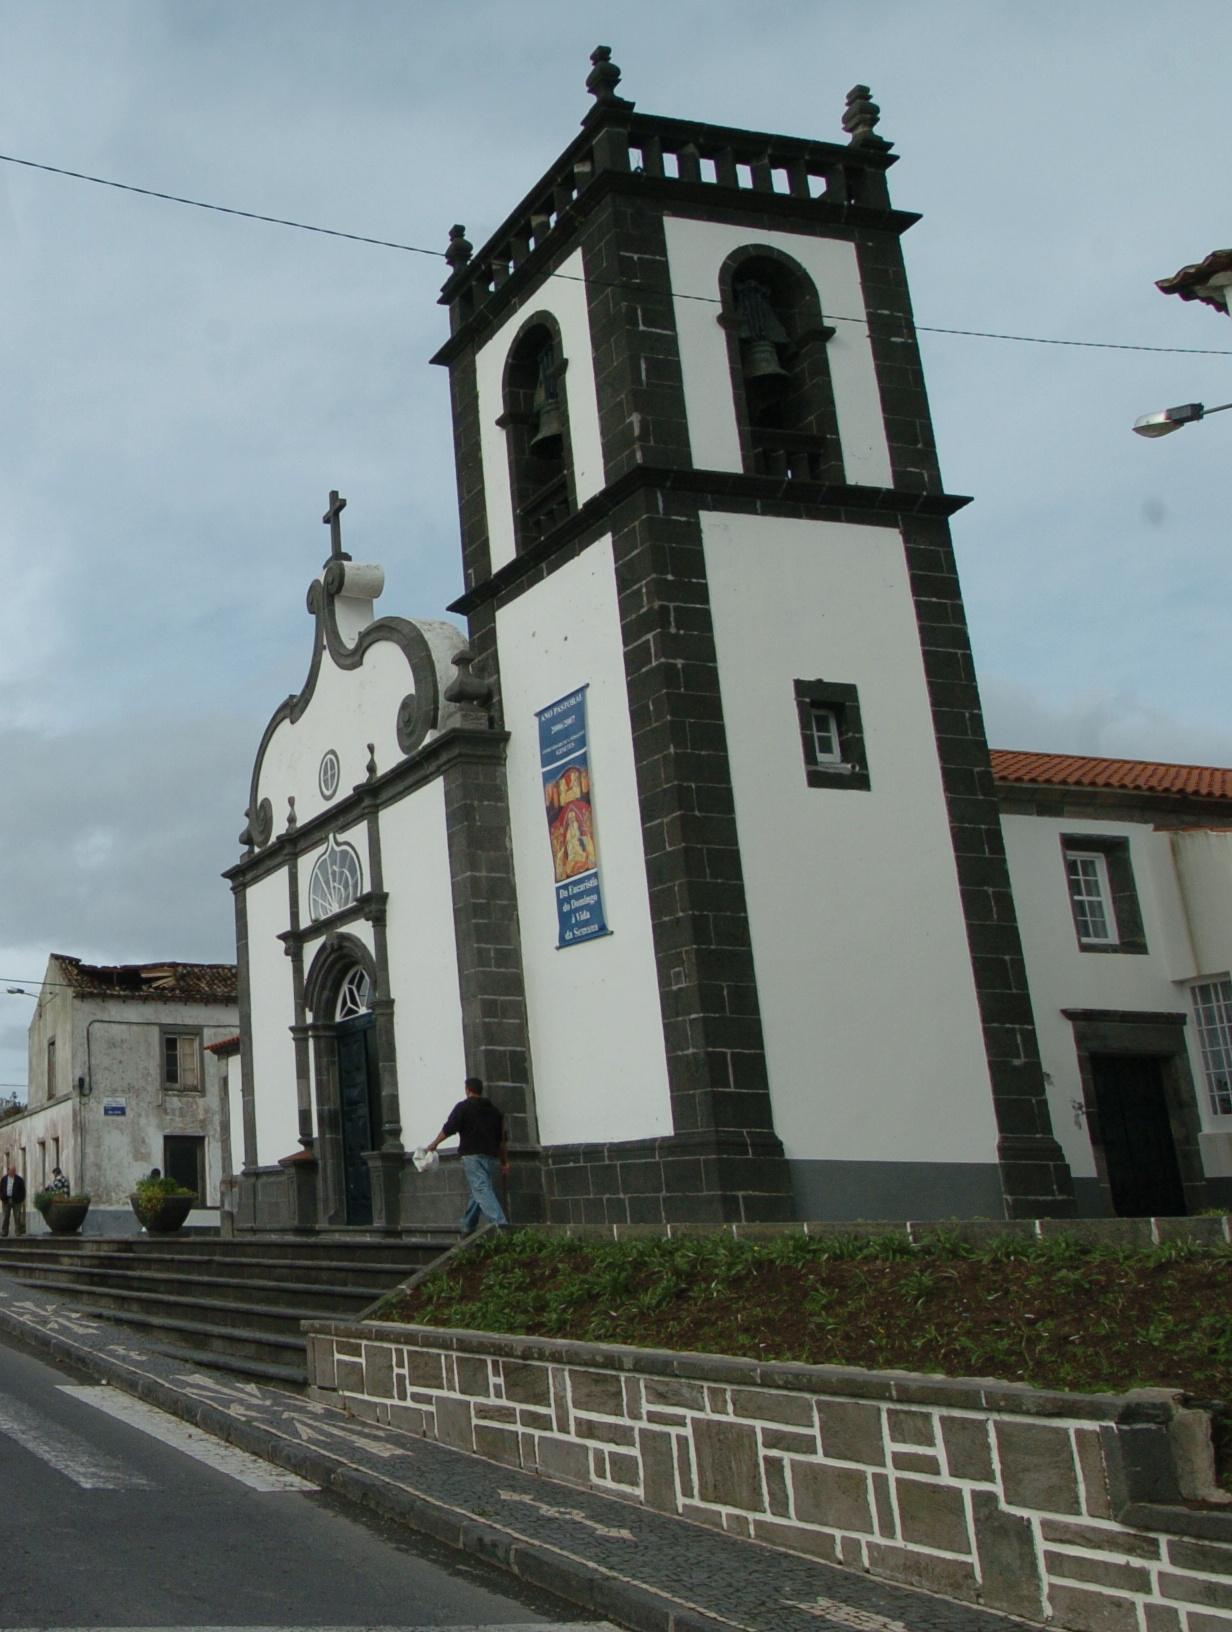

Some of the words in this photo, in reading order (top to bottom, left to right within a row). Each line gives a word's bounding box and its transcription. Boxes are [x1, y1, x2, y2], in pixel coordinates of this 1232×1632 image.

[541, 710, 553, 721] ANO
[553, 692, 583, 716] PASTORAL
[568, 876, 598, 895] Eucaristia
[562, 902, 571, 912] do
[570, 894, 598, 909] Domingo
[575, 909, 591, 921] Vida
[564, 929, 574, 940] da
[573, 923, 599, 938] Semana
